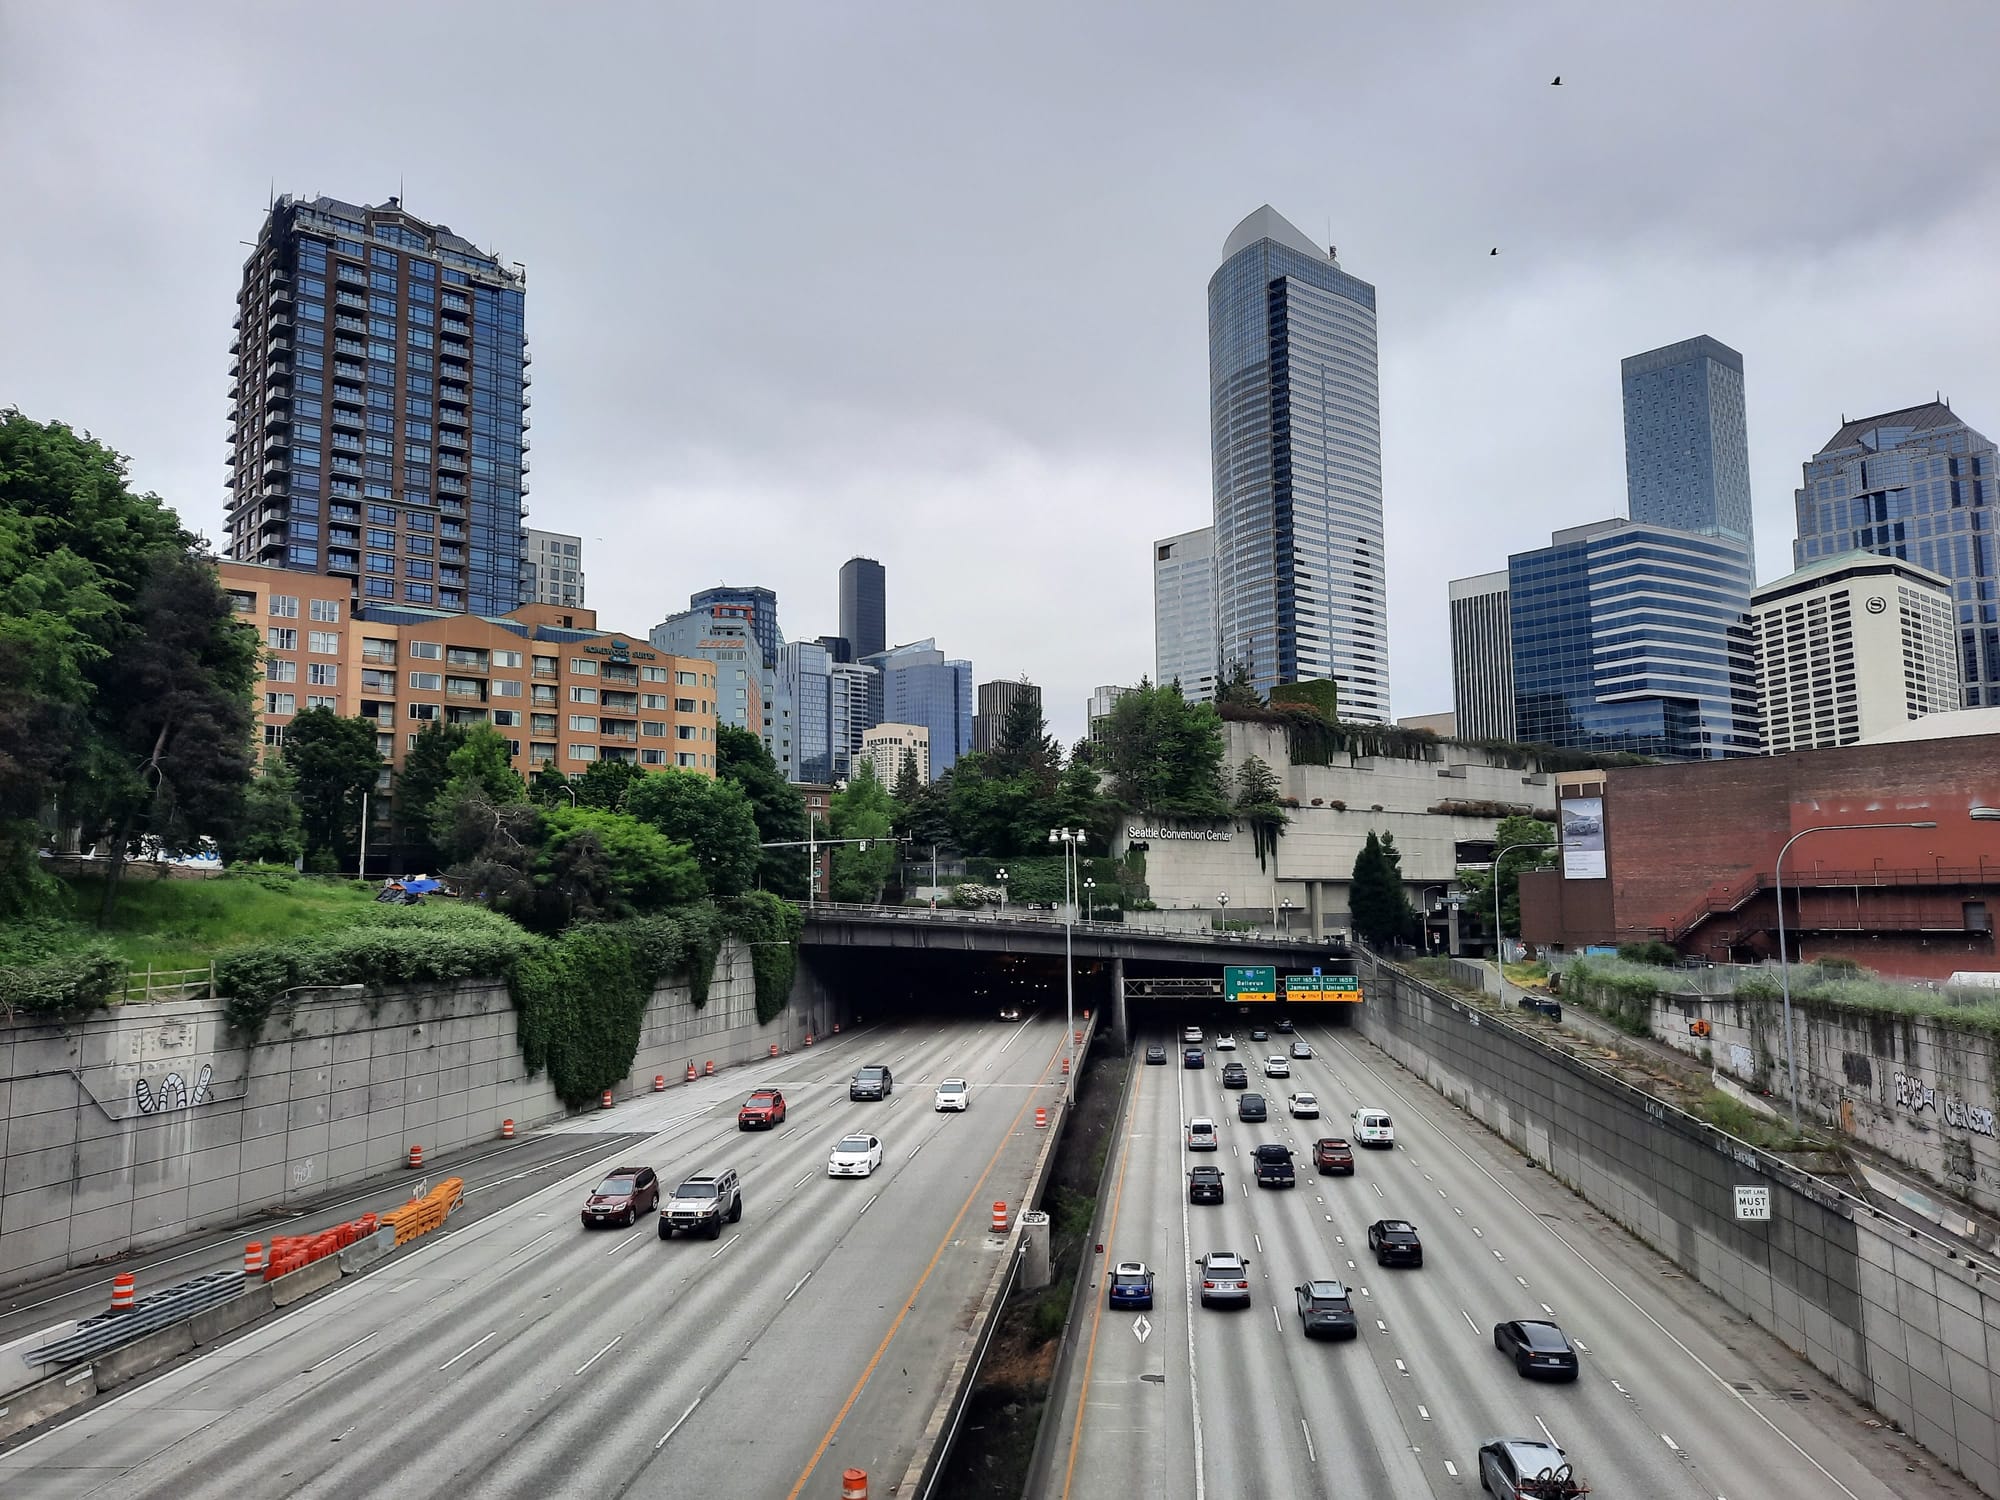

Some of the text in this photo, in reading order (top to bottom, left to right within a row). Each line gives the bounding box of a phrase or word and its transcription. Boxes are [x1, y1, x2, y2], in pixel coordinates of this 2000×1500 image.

[1128, 826, 1233, 841] Seattle Convention Center
[1739, 1197, 1766, 1206] MUST
[1743, 1208, 1764, 1217] EXIT
